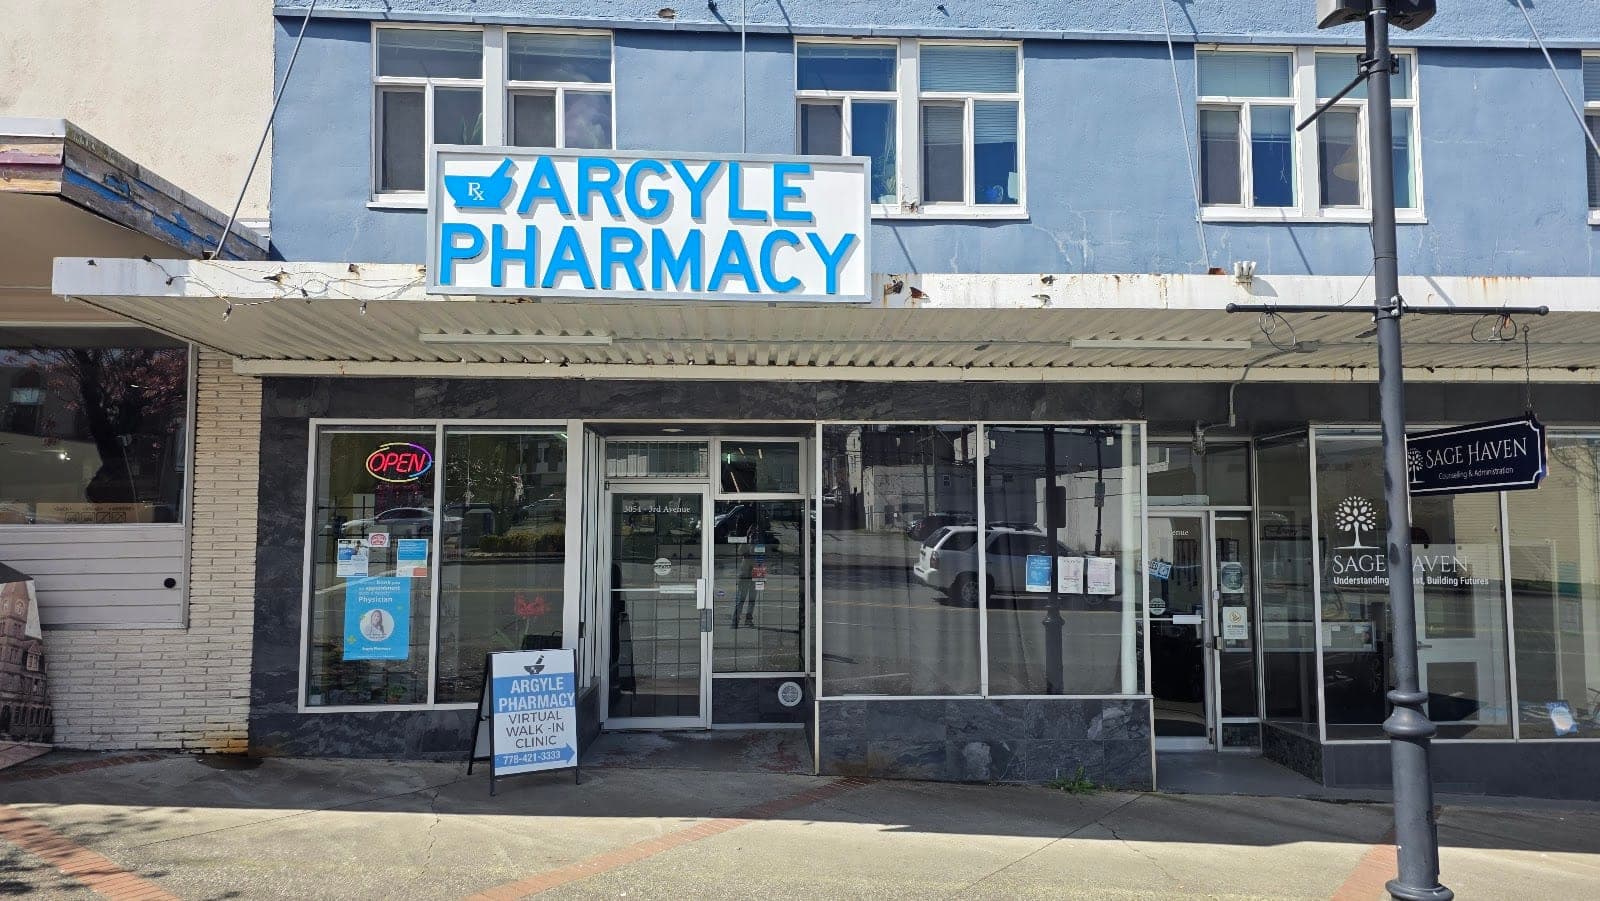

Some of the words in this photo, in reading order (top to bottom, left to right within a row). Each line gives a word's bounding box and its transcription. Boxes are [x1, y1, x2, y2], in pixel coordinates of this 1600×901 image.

[517, 156, 813, 223] ARGYLE
[440, 223, 860, 295] PHARMACY
[1426, 445, 1464, 469] SAGE
[1468, 437, 1527, 466] HAVEN
[369, 452, 426, 473] OPEN
[1474, 466, 1514, 477] Administration
[649, 505, 662, 513] 3rd
[663, 505, 691, 513] Avenue
[1332, 554, 1387, 574] SAGE
[1412, 555, 1469, 573] AVEN
[1333, 576, 1390, 586] Understanding
[1427, 576, 1458, 587] Building
[1460, 577, 1489, 585] Futures
[358, 596, 393, 604] Physician
[510, 676, 565, 694] ARGYLE
[498, 692, 575, 712] PHARMACY
[508, 710, 563, 725] VIRTUAL
[506, 726, 544, 737] WALK
[515, 735, 557, 749] CLINIC
[503, 750, 561, 765] 778-421-3333
